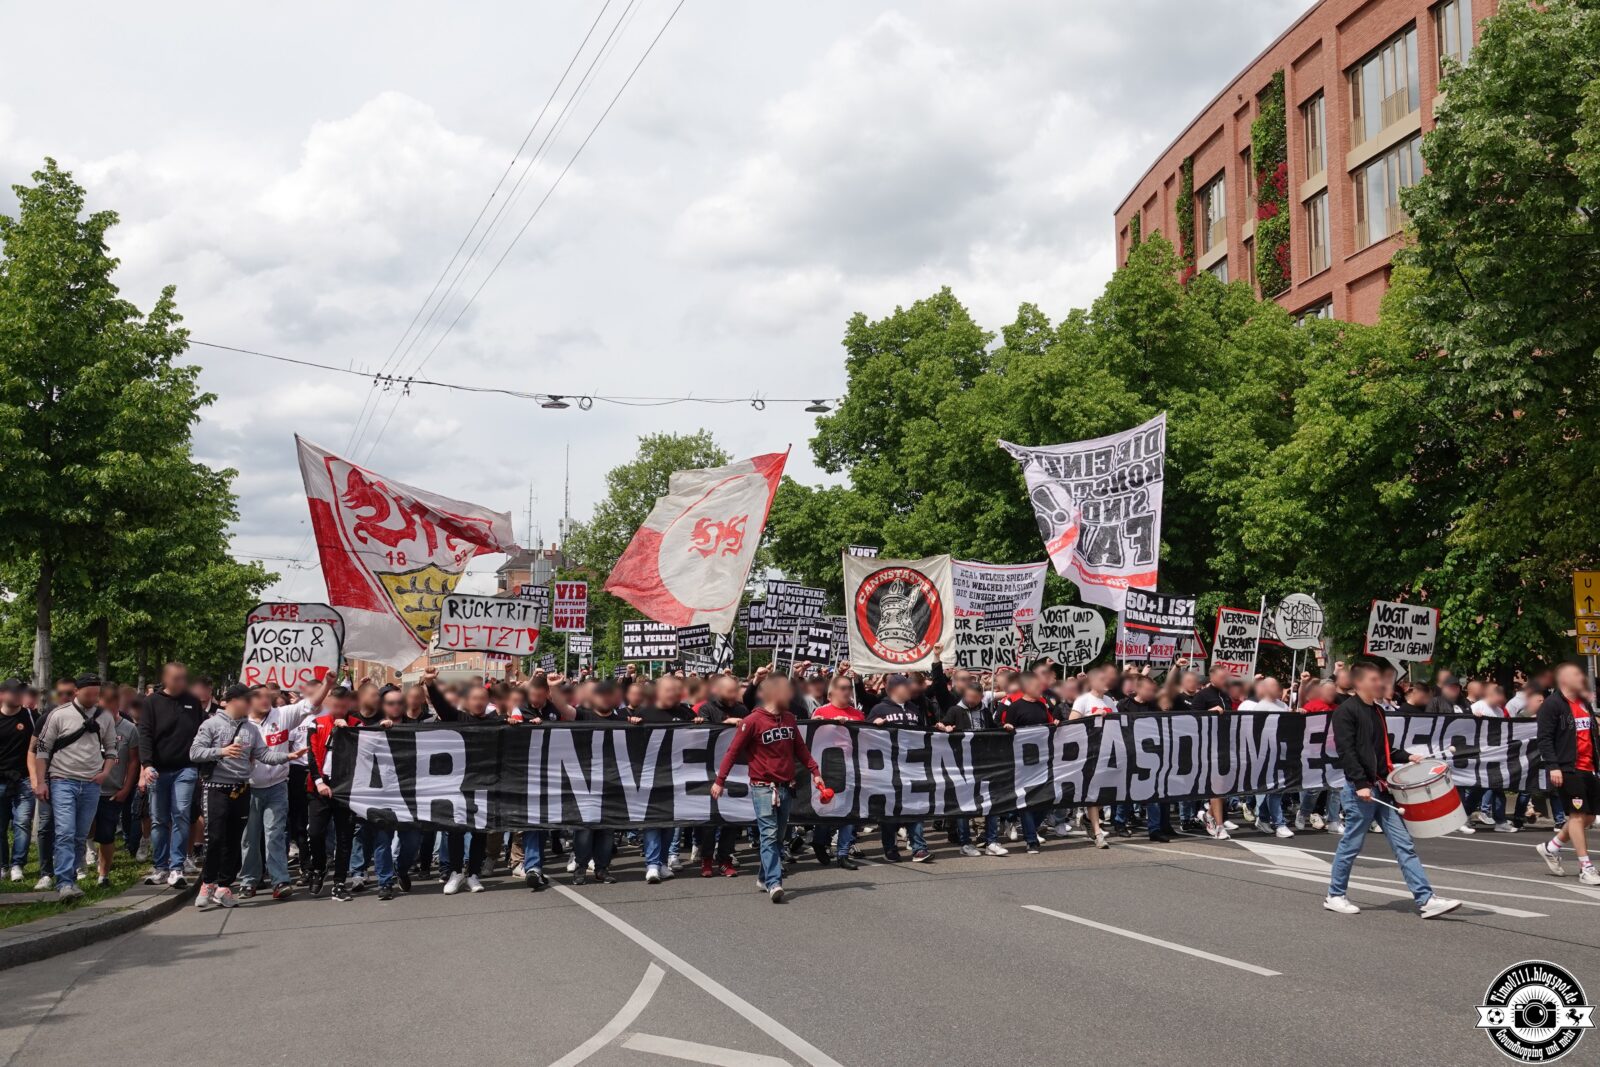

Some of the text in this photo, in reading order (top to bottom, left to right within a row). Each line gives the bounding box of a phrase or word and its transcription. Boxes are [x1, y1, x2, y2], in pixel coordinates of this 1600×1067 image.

[386, 551, 406, 565] 18
[850, 548, 877, 557] VOGT
[1584, 578, 1592, 588] U
[956, 589, 967, 597] DIE
[783, 603, 822, 618] MAUL
[1126, 591, 1196, 616] 50+1 IST
[554, 616, 585, 628] WIR
[1042, 608, 1094, 624] VOGT UND
[1126, 609, 1194, 626] UNANTASTBAR
[1221, 611, 1259, 626] VERRATEN
[1377, 604, 1430, 625] VOGT und
[624, 623, 675, 632] IHR MACHT
[954, 618, 971, 630] ÜR
[1038, 623, 1075, 639] ADRION
[1227, 625, 1246, 636] UND
[1371, 623, 1413, 640] ADRION
[251, 626, 324, 647] VOGT &
[443, 624, 540, 651] JETZT!
[624, 634, 676, 643] DEN VEREIN
[679, 635, 710, 647] JETZT
[955, 632, 994, 646] TARKEN
[1218, 634, 1257, 649] VERKAUFT
[569, 645, 592, 653] MAUL
[624, 645, 676, 657] KAPUTT
[873, 641, 930, 662] KURVE
[1039, 638, 1092, 653] ZEIT ZU
[1369, 640, 1394, 652] ZEIT
[1392, 643, 1405, 653] ZU
[955, 650, 977, 667] OGT
[1215, 662, 1249, 675] ETZT!
[762, 726, 796, 745] CC97
[527, 724, 991, 823] INVESOREN,
[1012, 713, 1287, 809] PRÄSIDIUM:
